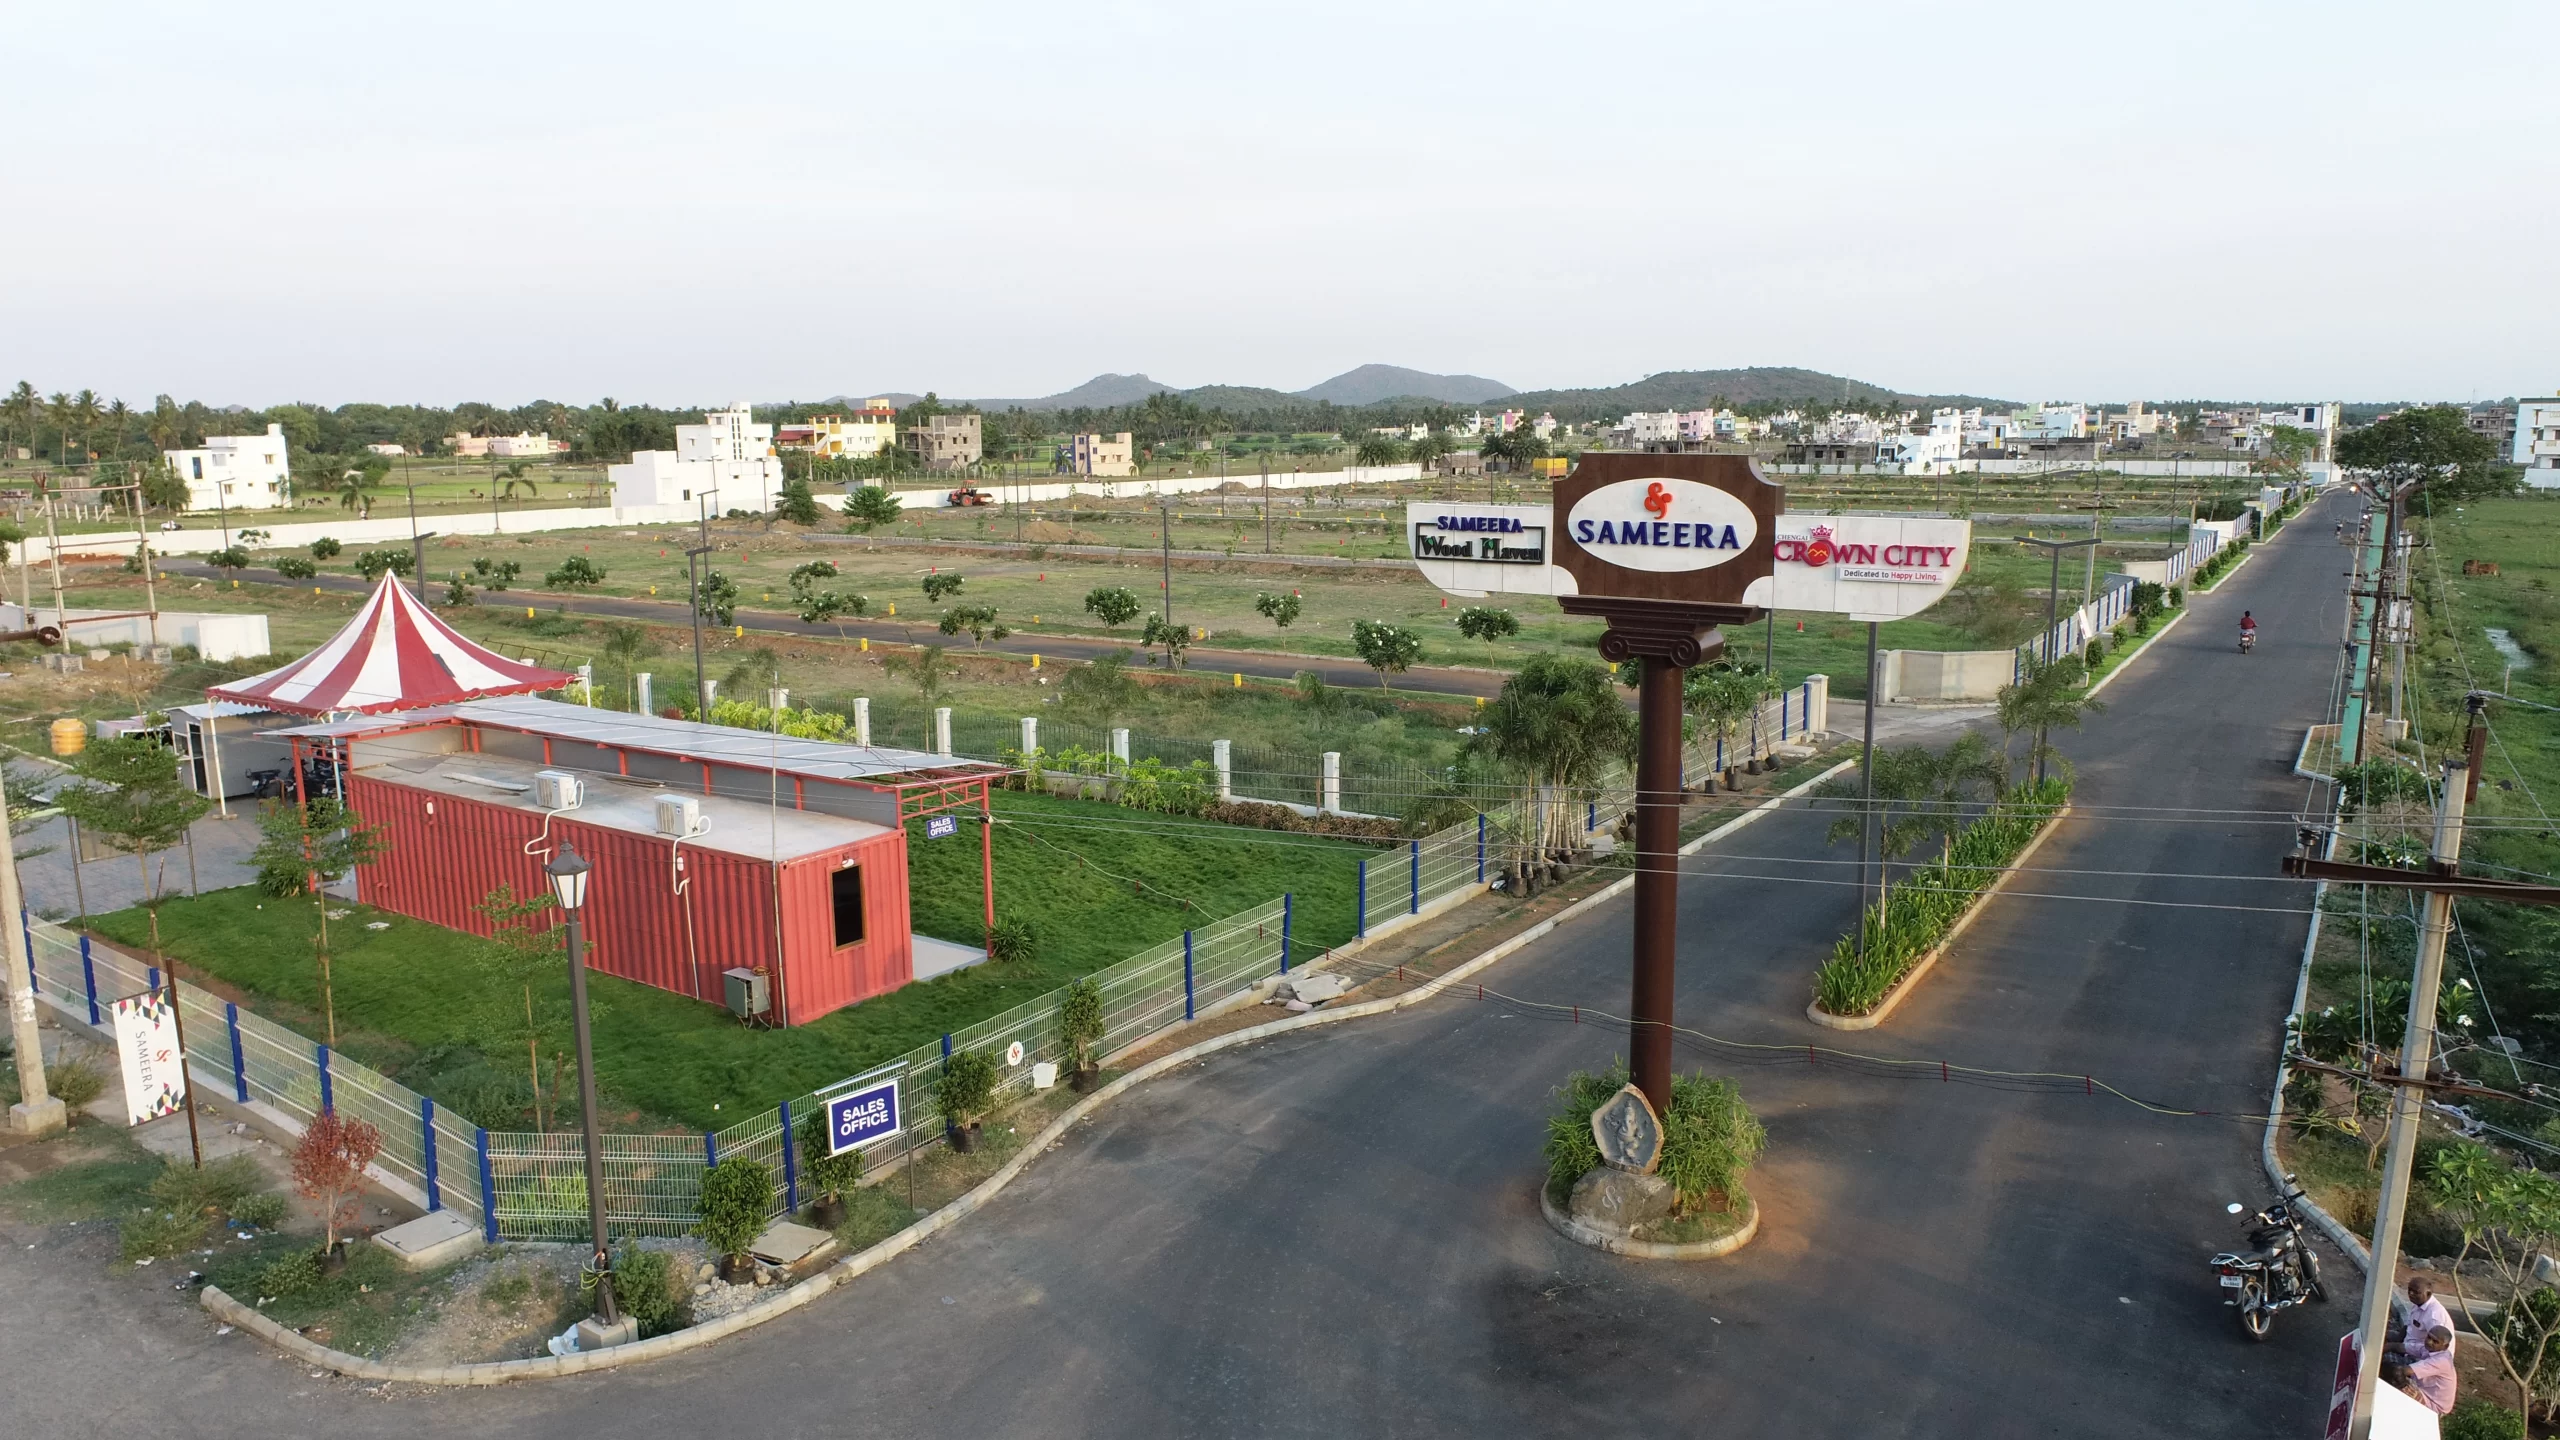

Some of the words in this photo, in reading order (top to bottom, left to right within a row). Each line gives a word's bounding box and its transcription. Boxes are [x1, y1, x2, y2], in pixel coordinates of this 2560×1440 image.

[1437, 515, 1524, 533] SAMEERA
[1577, 520, 1741, 549] SAMEERA
[1418, 535, 1473, 557] Wood
[1480, 537, 1541, 561] Haven
[1773, 540, 1878, 567] CROWN
[1884, 545, 1956, 567] CITY
[1844, 569, 1879, 578] Dedicated
[1891, 571, 1912, 581] Happy
[930, 817, 951, 829] SALES
[930, 824, 953, 836] OFFICE
[135, 1031, 154, 1092] SAMEERA
[842, 1097, 885, 1122] SALES
[840, 1109, 889, 1136] OFFICE
